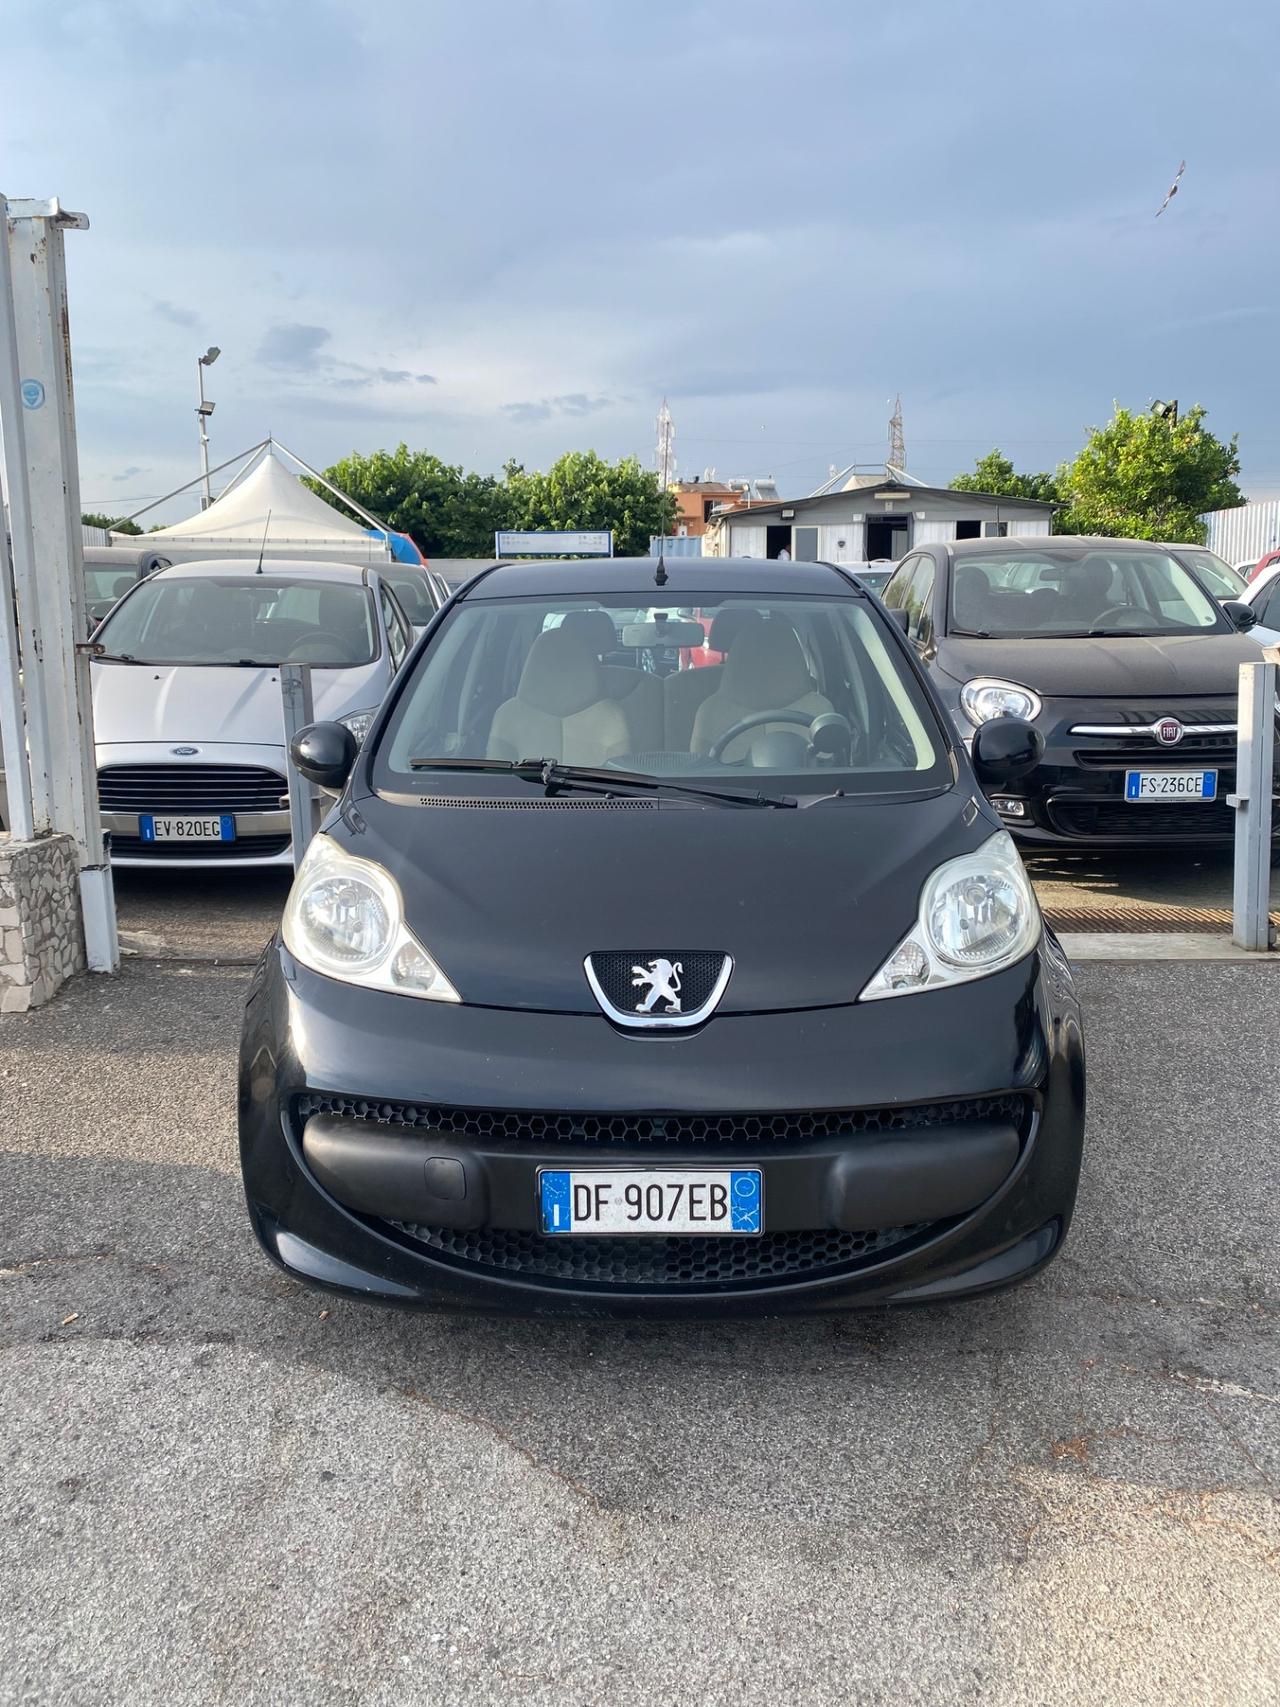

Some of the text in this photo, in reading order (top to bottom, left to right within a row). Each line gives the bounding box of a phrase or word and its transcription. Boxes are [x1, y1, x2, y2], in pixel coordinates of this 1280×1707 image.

[1163, 727, 1177, 738] FIAT
[1141, 777, 1203, 793] FS 236CE
[154, 820, 220, 837] EV 820EG
[573, 1184, 728, 1221] DF 907EB
